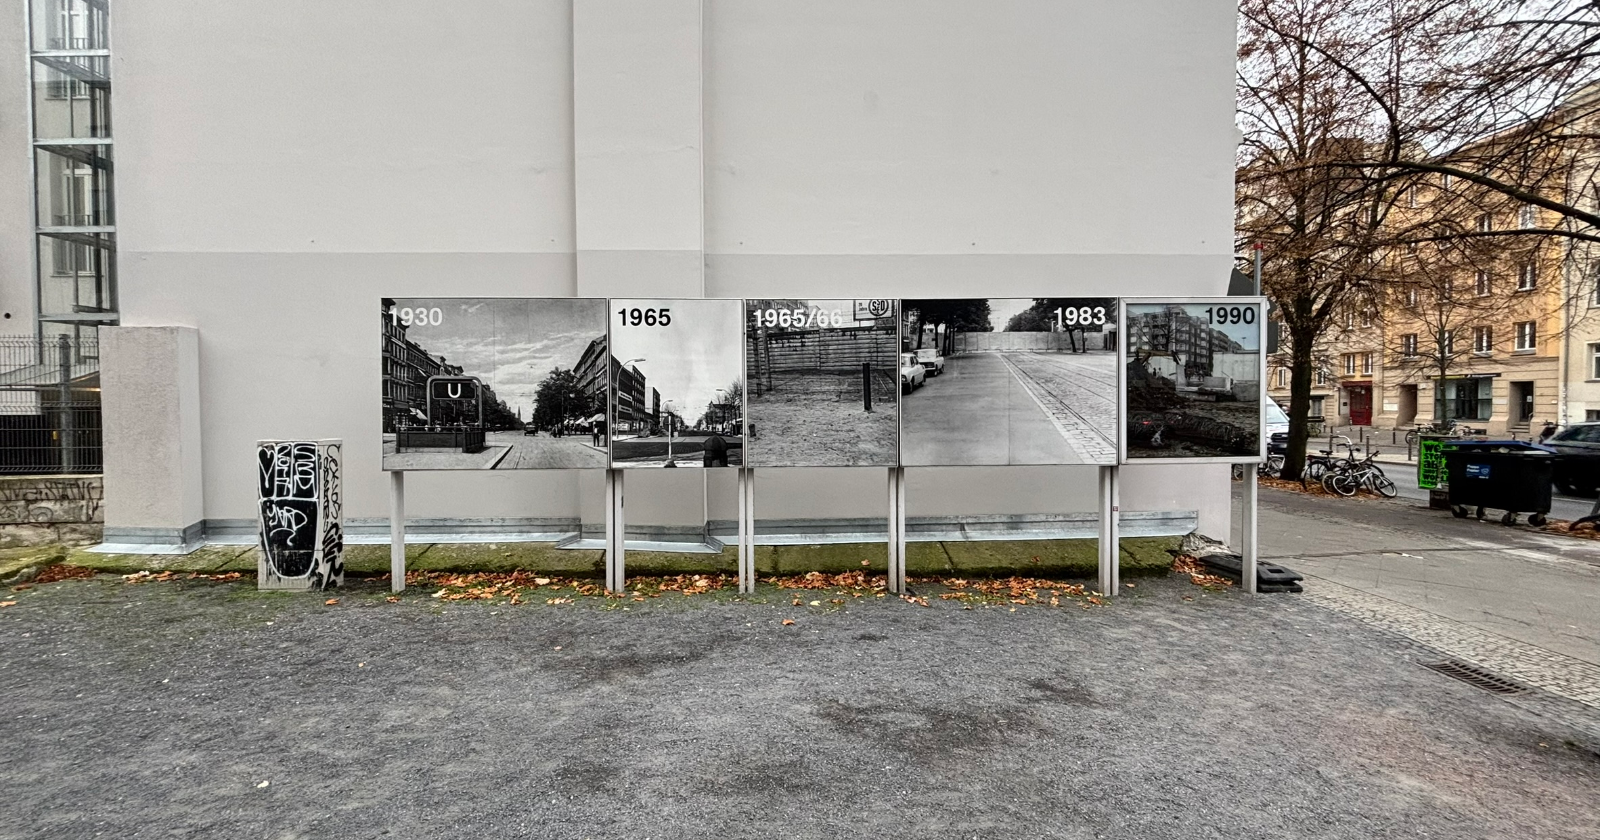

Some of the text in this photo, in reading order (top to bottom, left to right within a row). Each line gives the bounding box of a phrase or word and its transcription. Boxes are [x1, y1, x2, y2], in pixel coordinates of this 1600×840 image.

[388, 307, 443, 326] 1930
[617, 307, 672, 327] 1965
[753, 308, 843, 328] 1965/66
[1053, 306, 1106, 325] 1983
[1205, 306, 1255, 325] 1990
[447, 382, 462, 399] U
